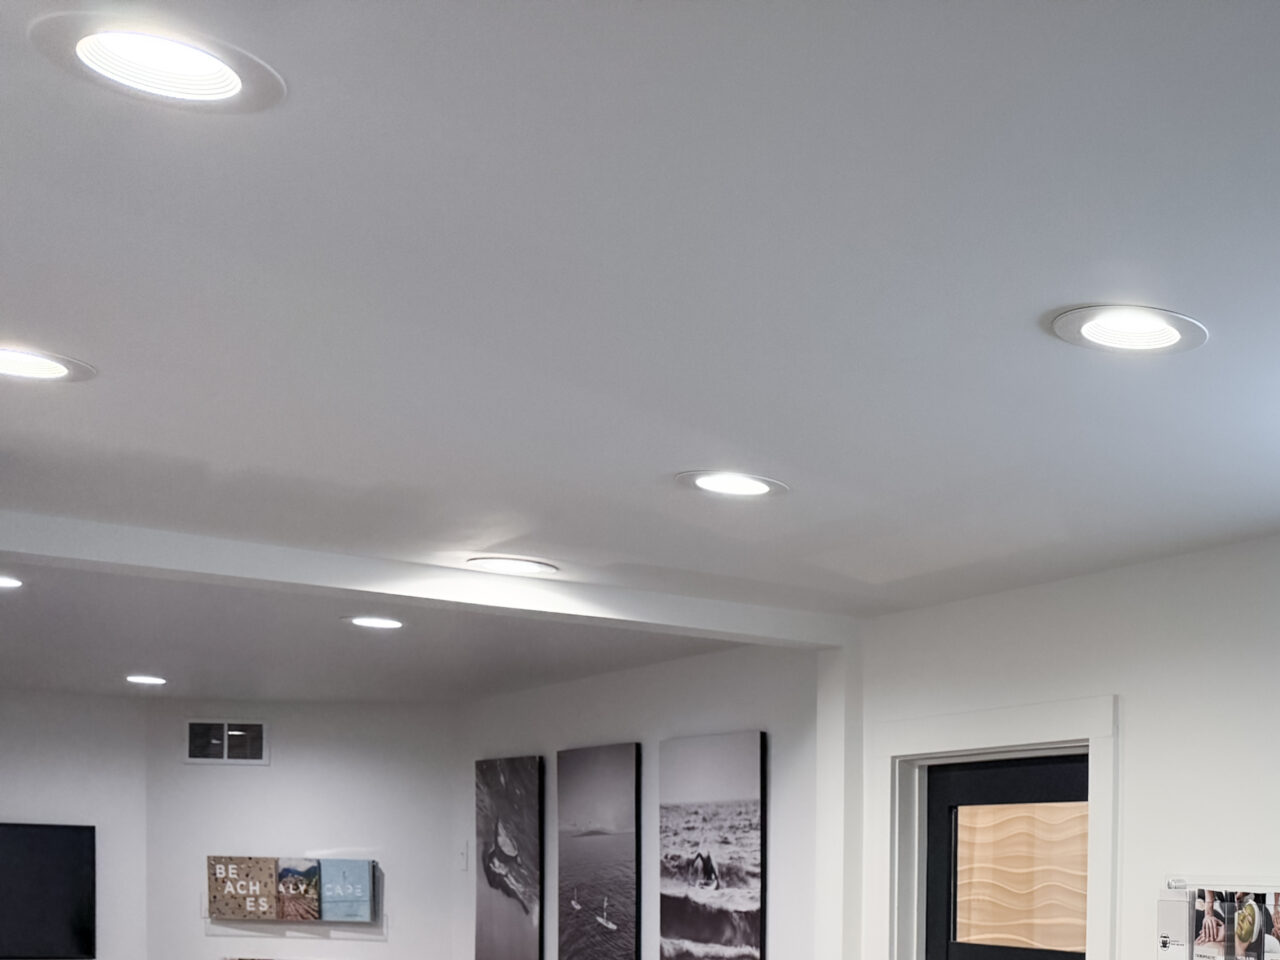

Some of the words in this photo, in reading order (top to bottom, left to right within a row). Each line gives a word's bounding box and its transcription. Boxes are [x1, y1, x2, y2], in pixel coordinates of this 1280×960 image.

[215, 864, 238, 878] BE
[223, 881, 261, 895] ACH
[246, 897, 269, 912] ES
